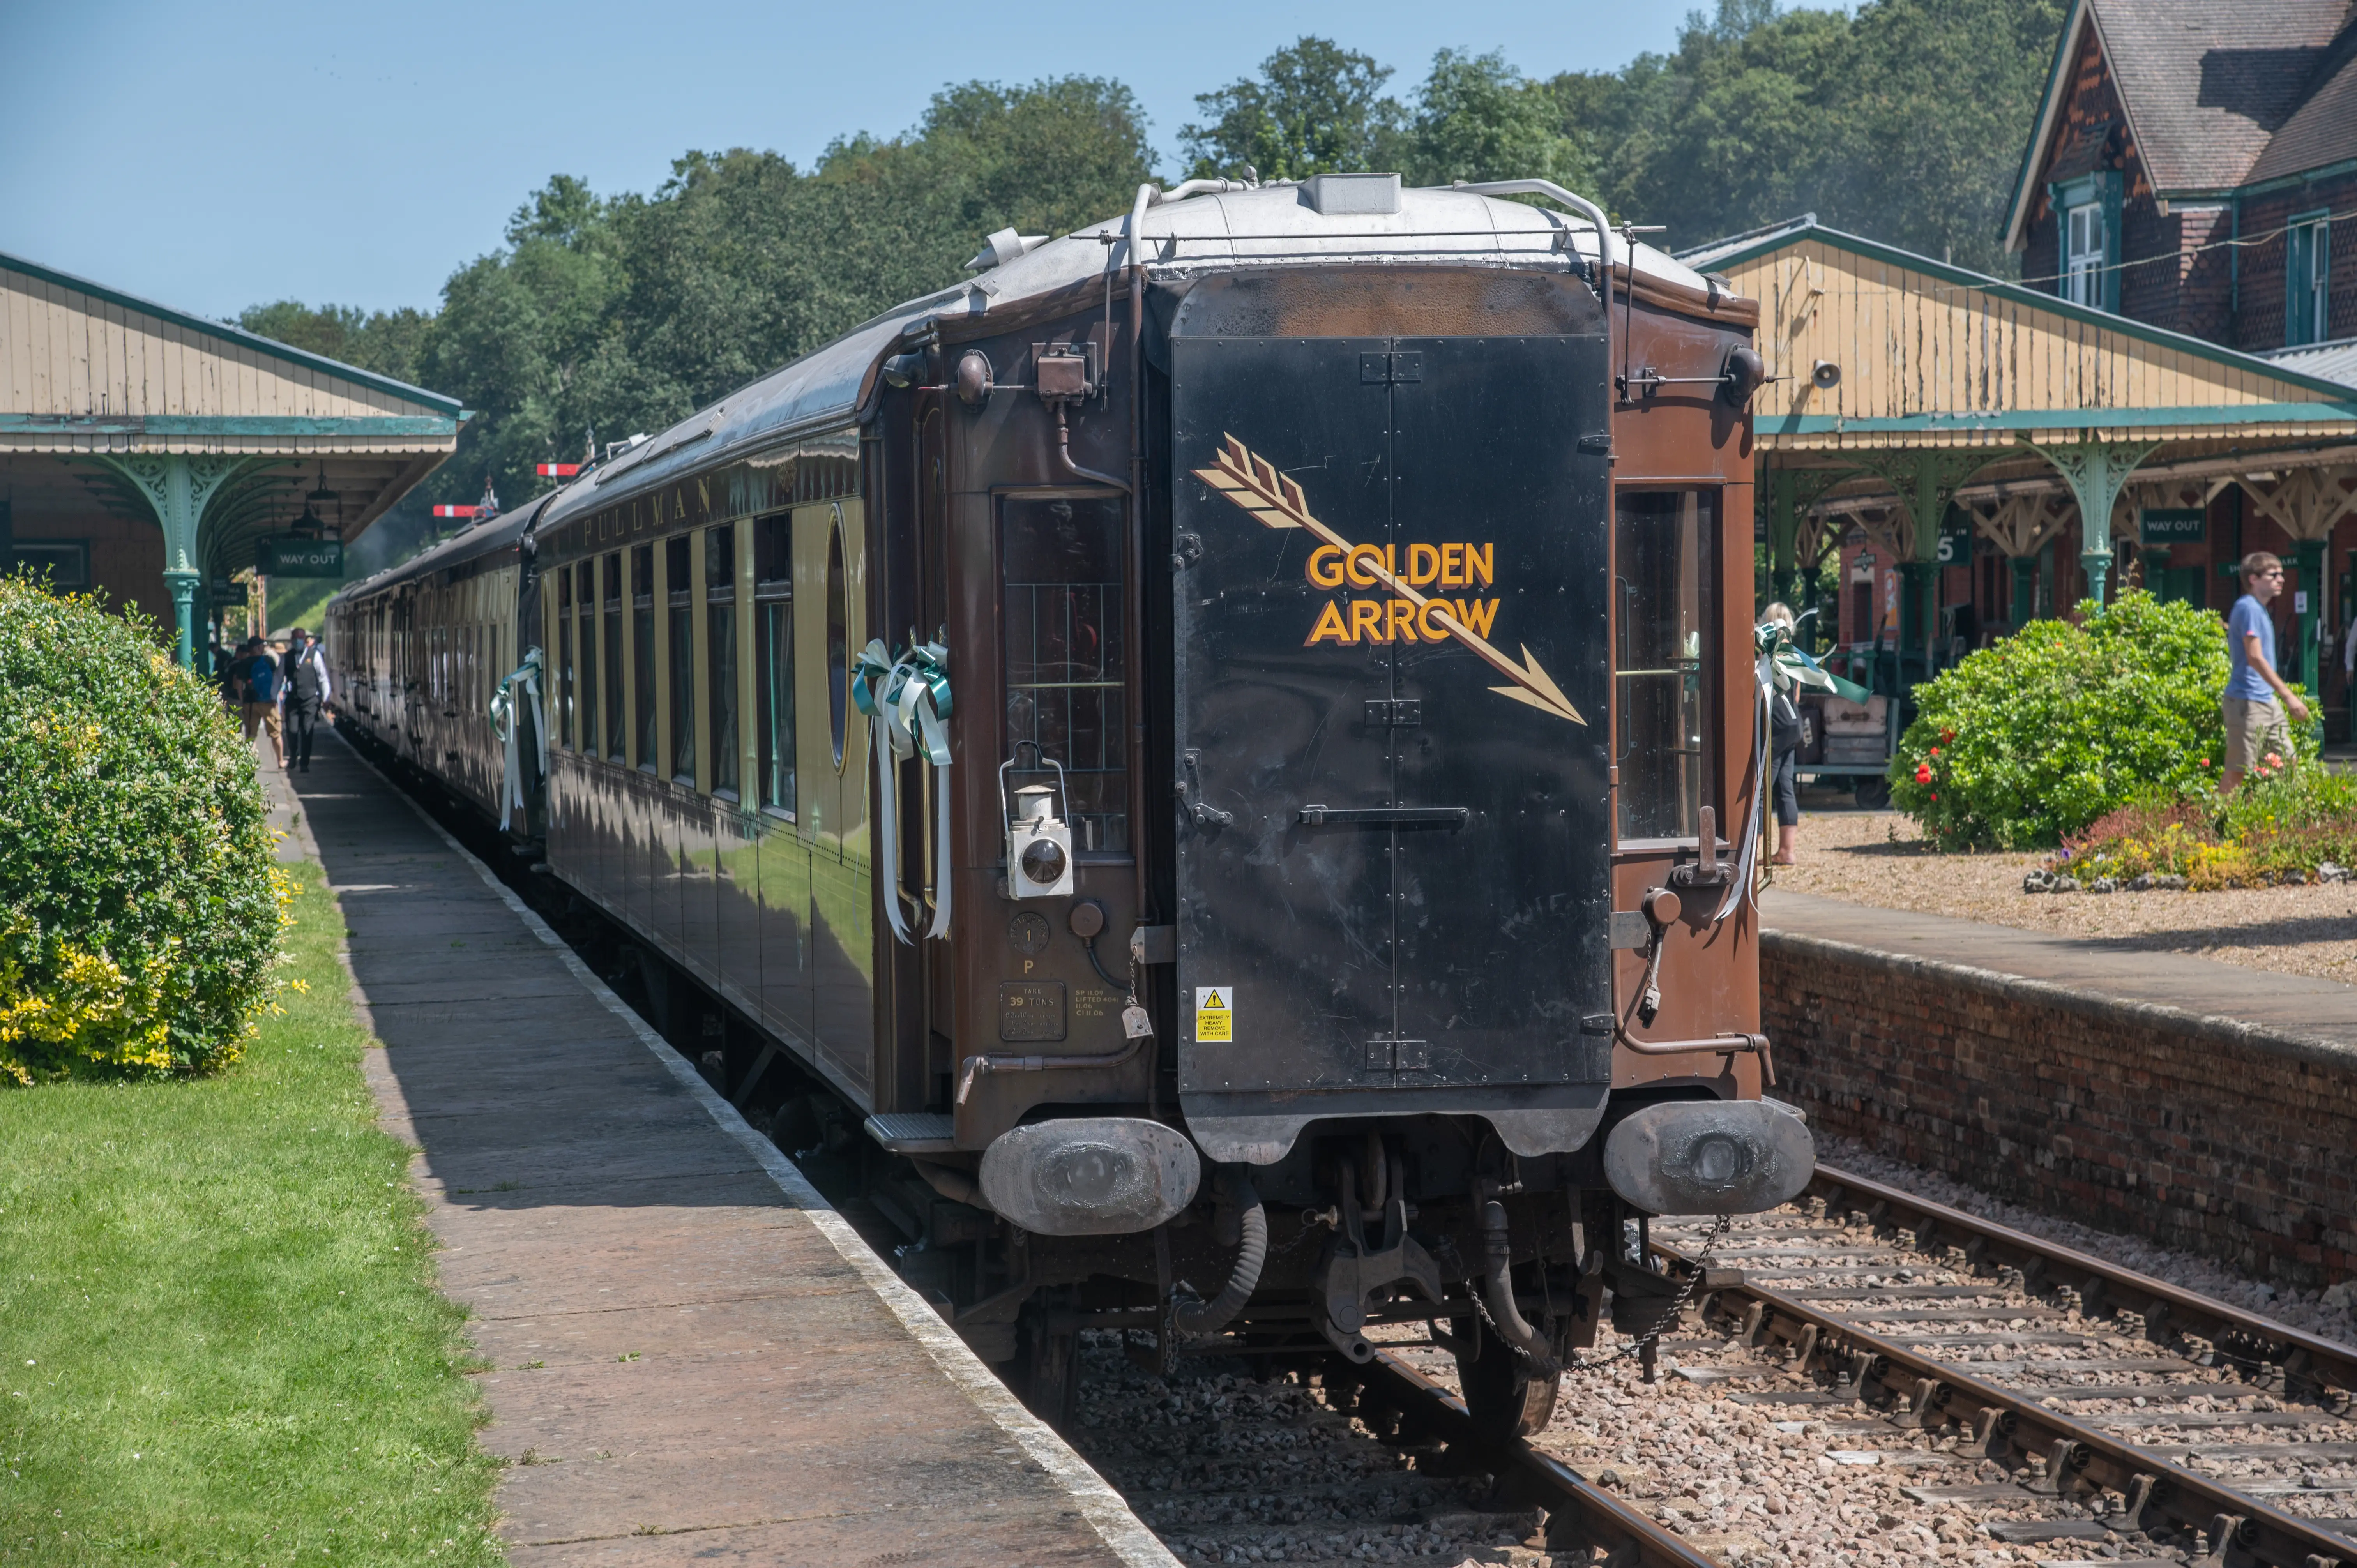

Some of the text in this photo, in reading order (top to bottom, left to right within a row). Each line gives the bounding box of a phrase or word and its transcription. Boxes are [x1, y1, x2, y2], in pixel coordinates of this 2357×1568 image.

[584, 475, 711, 546] PULLMAN
[2147, 520, 2200, 531] WAY OUT
[1938, 536, 1954, 561] 5
[279, 554, 336, 564] WAY OUT
[2282, 557, 2299, 565] ARK
[1305, 542, 1493, 590] GOLDEN
[1304, 598, 1500, 647] ARROW
[1026, 929, 1031, 941] 1
[1025, 960, 1034, 974] P
[1010, 997, 1024, 1006] 39
